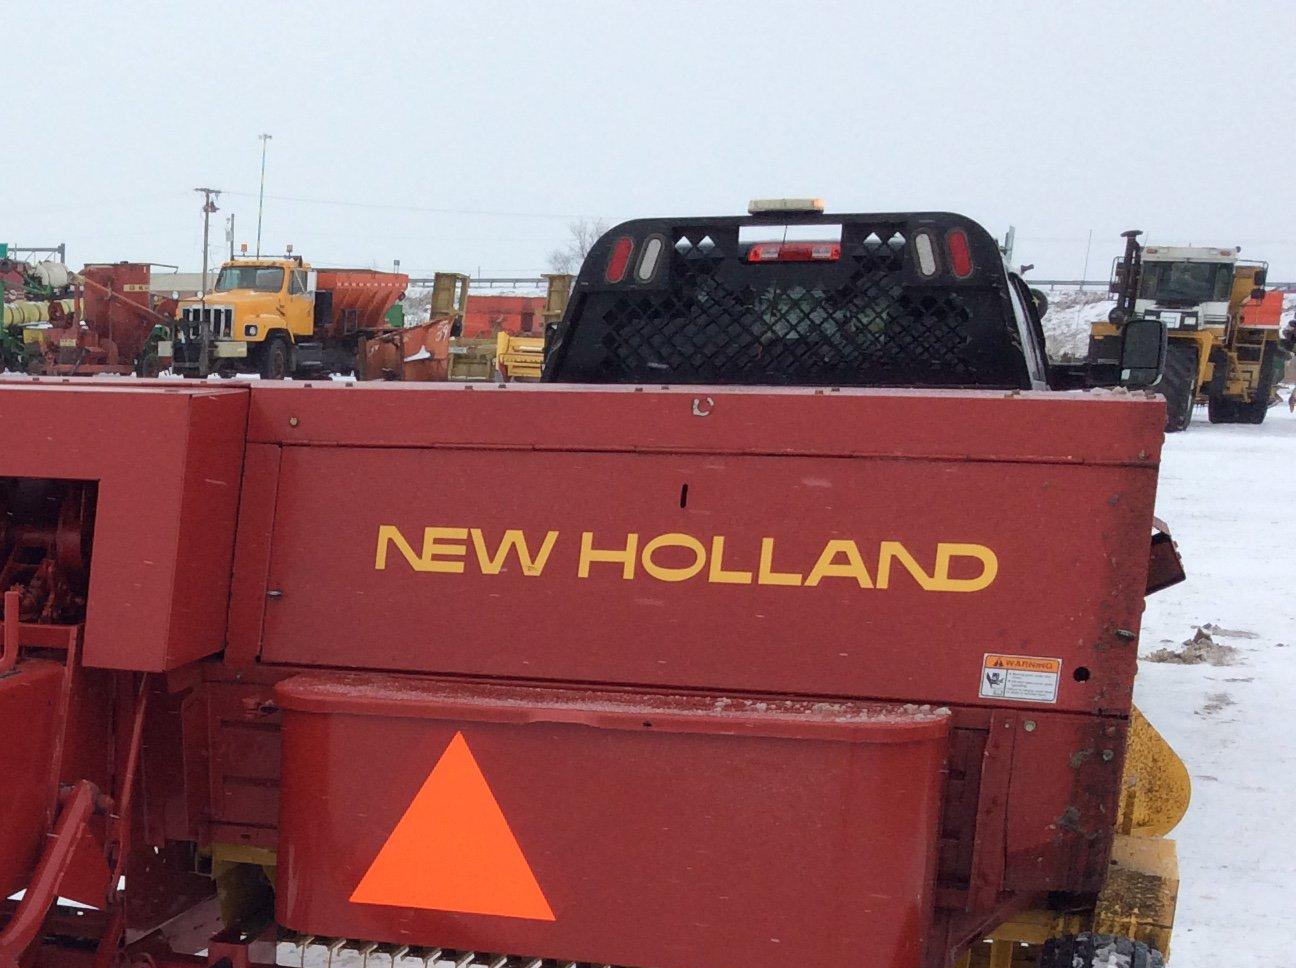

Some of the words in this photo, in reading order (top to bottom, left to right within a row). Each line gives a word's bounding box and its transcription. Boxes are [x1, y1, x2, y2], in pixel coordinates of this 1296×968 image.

[374, 525, 559, 577] NEW
[577, 531, 999, 593] HOLLAND
[1005, 659, 1053, 670] WARNING
